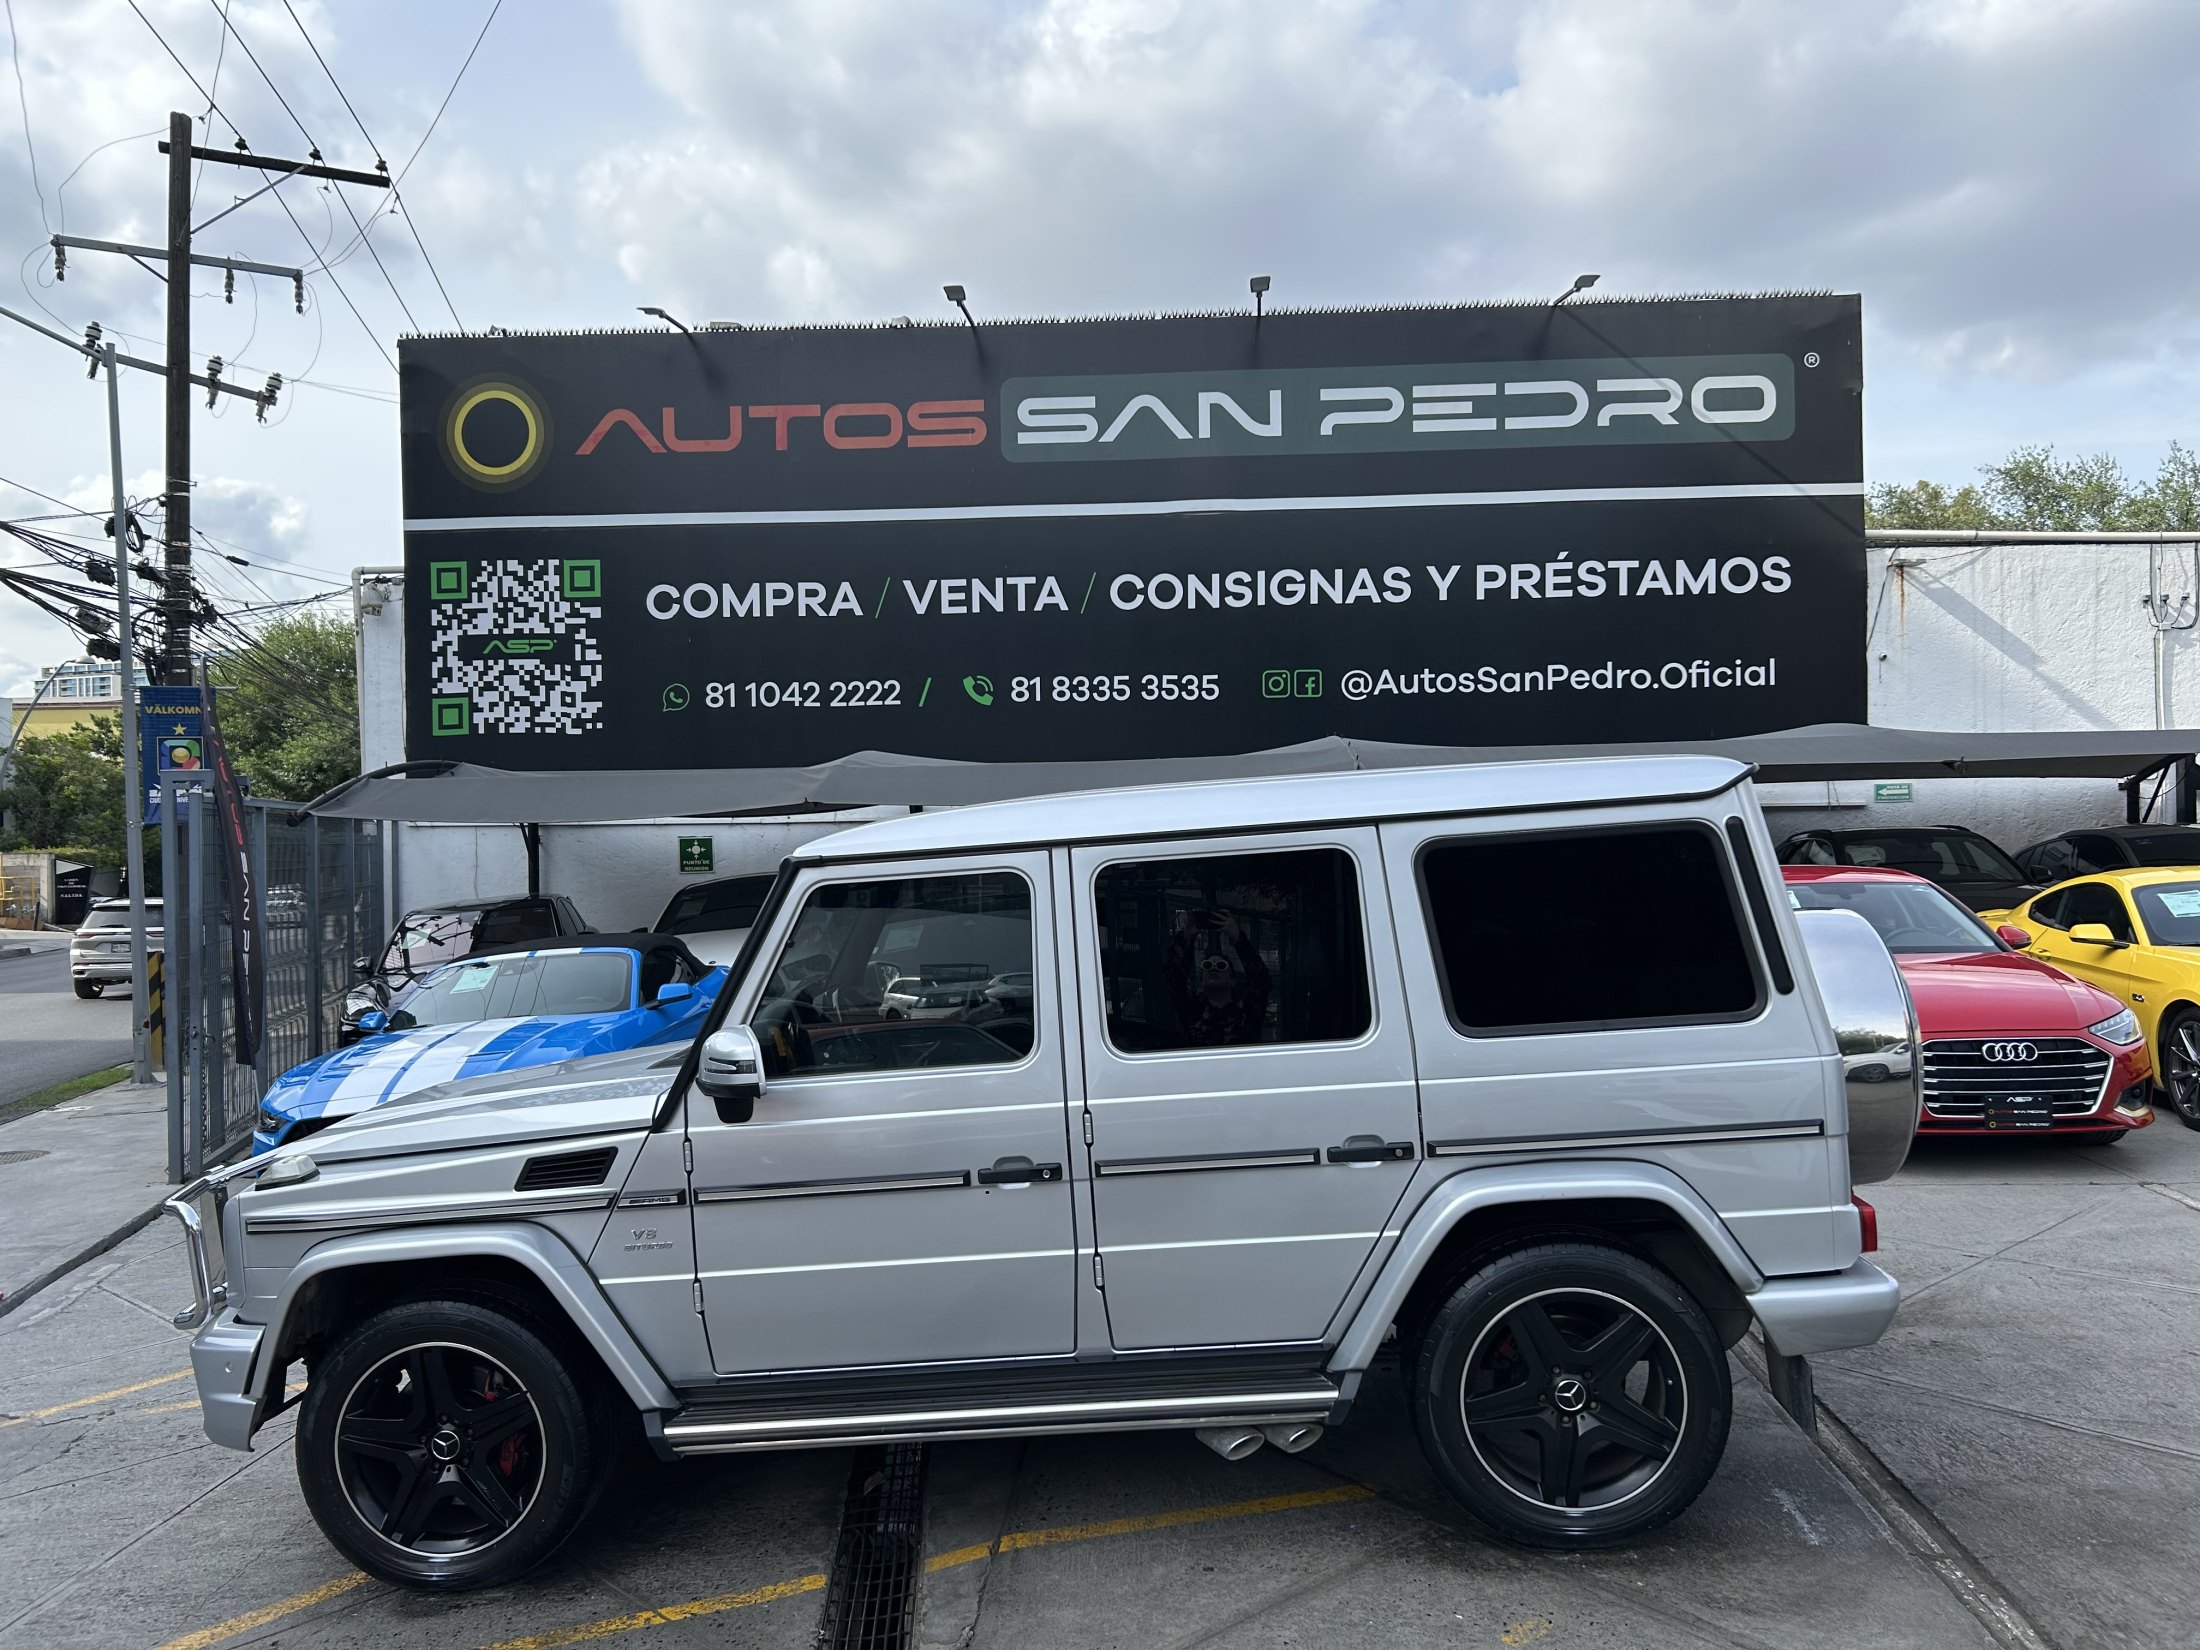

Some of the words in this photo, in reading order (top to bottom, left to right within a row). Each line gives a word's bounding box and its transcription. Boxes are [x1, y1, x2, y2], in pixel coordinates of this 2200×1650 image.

[578, 400, 987, 455] AUTOS
[1017, 390, 1282, 445] SAN
[1319, 375, 1777, 436] PEDRO
[646, 581, 864, 620] COMPRA
[902, 575, 1069, 615] VENTA
[1109, 566, 1412, 611] CONSIGNAS
[1425, 564, 1461, 601] Y
[1476, 551, 1792, 601] PRÉSTAMOS
[483, 639, 554, 654] ASP
[1010, 676, 1041, 703] 81
[1051, 675, 1131, 702] 8335
[1141, 674, 1220, 701] 3535
[1341, 657, 1776, 701] @AutosSanPedro.Oficial
[705, 682, 736, 708] 81
[745, 681, 821, 708] 1042
[829, 680, 902, 707] 2222
[145, 705, 203, 715] VÄLKOMN
[631, 1228, 657, 1240] V8
